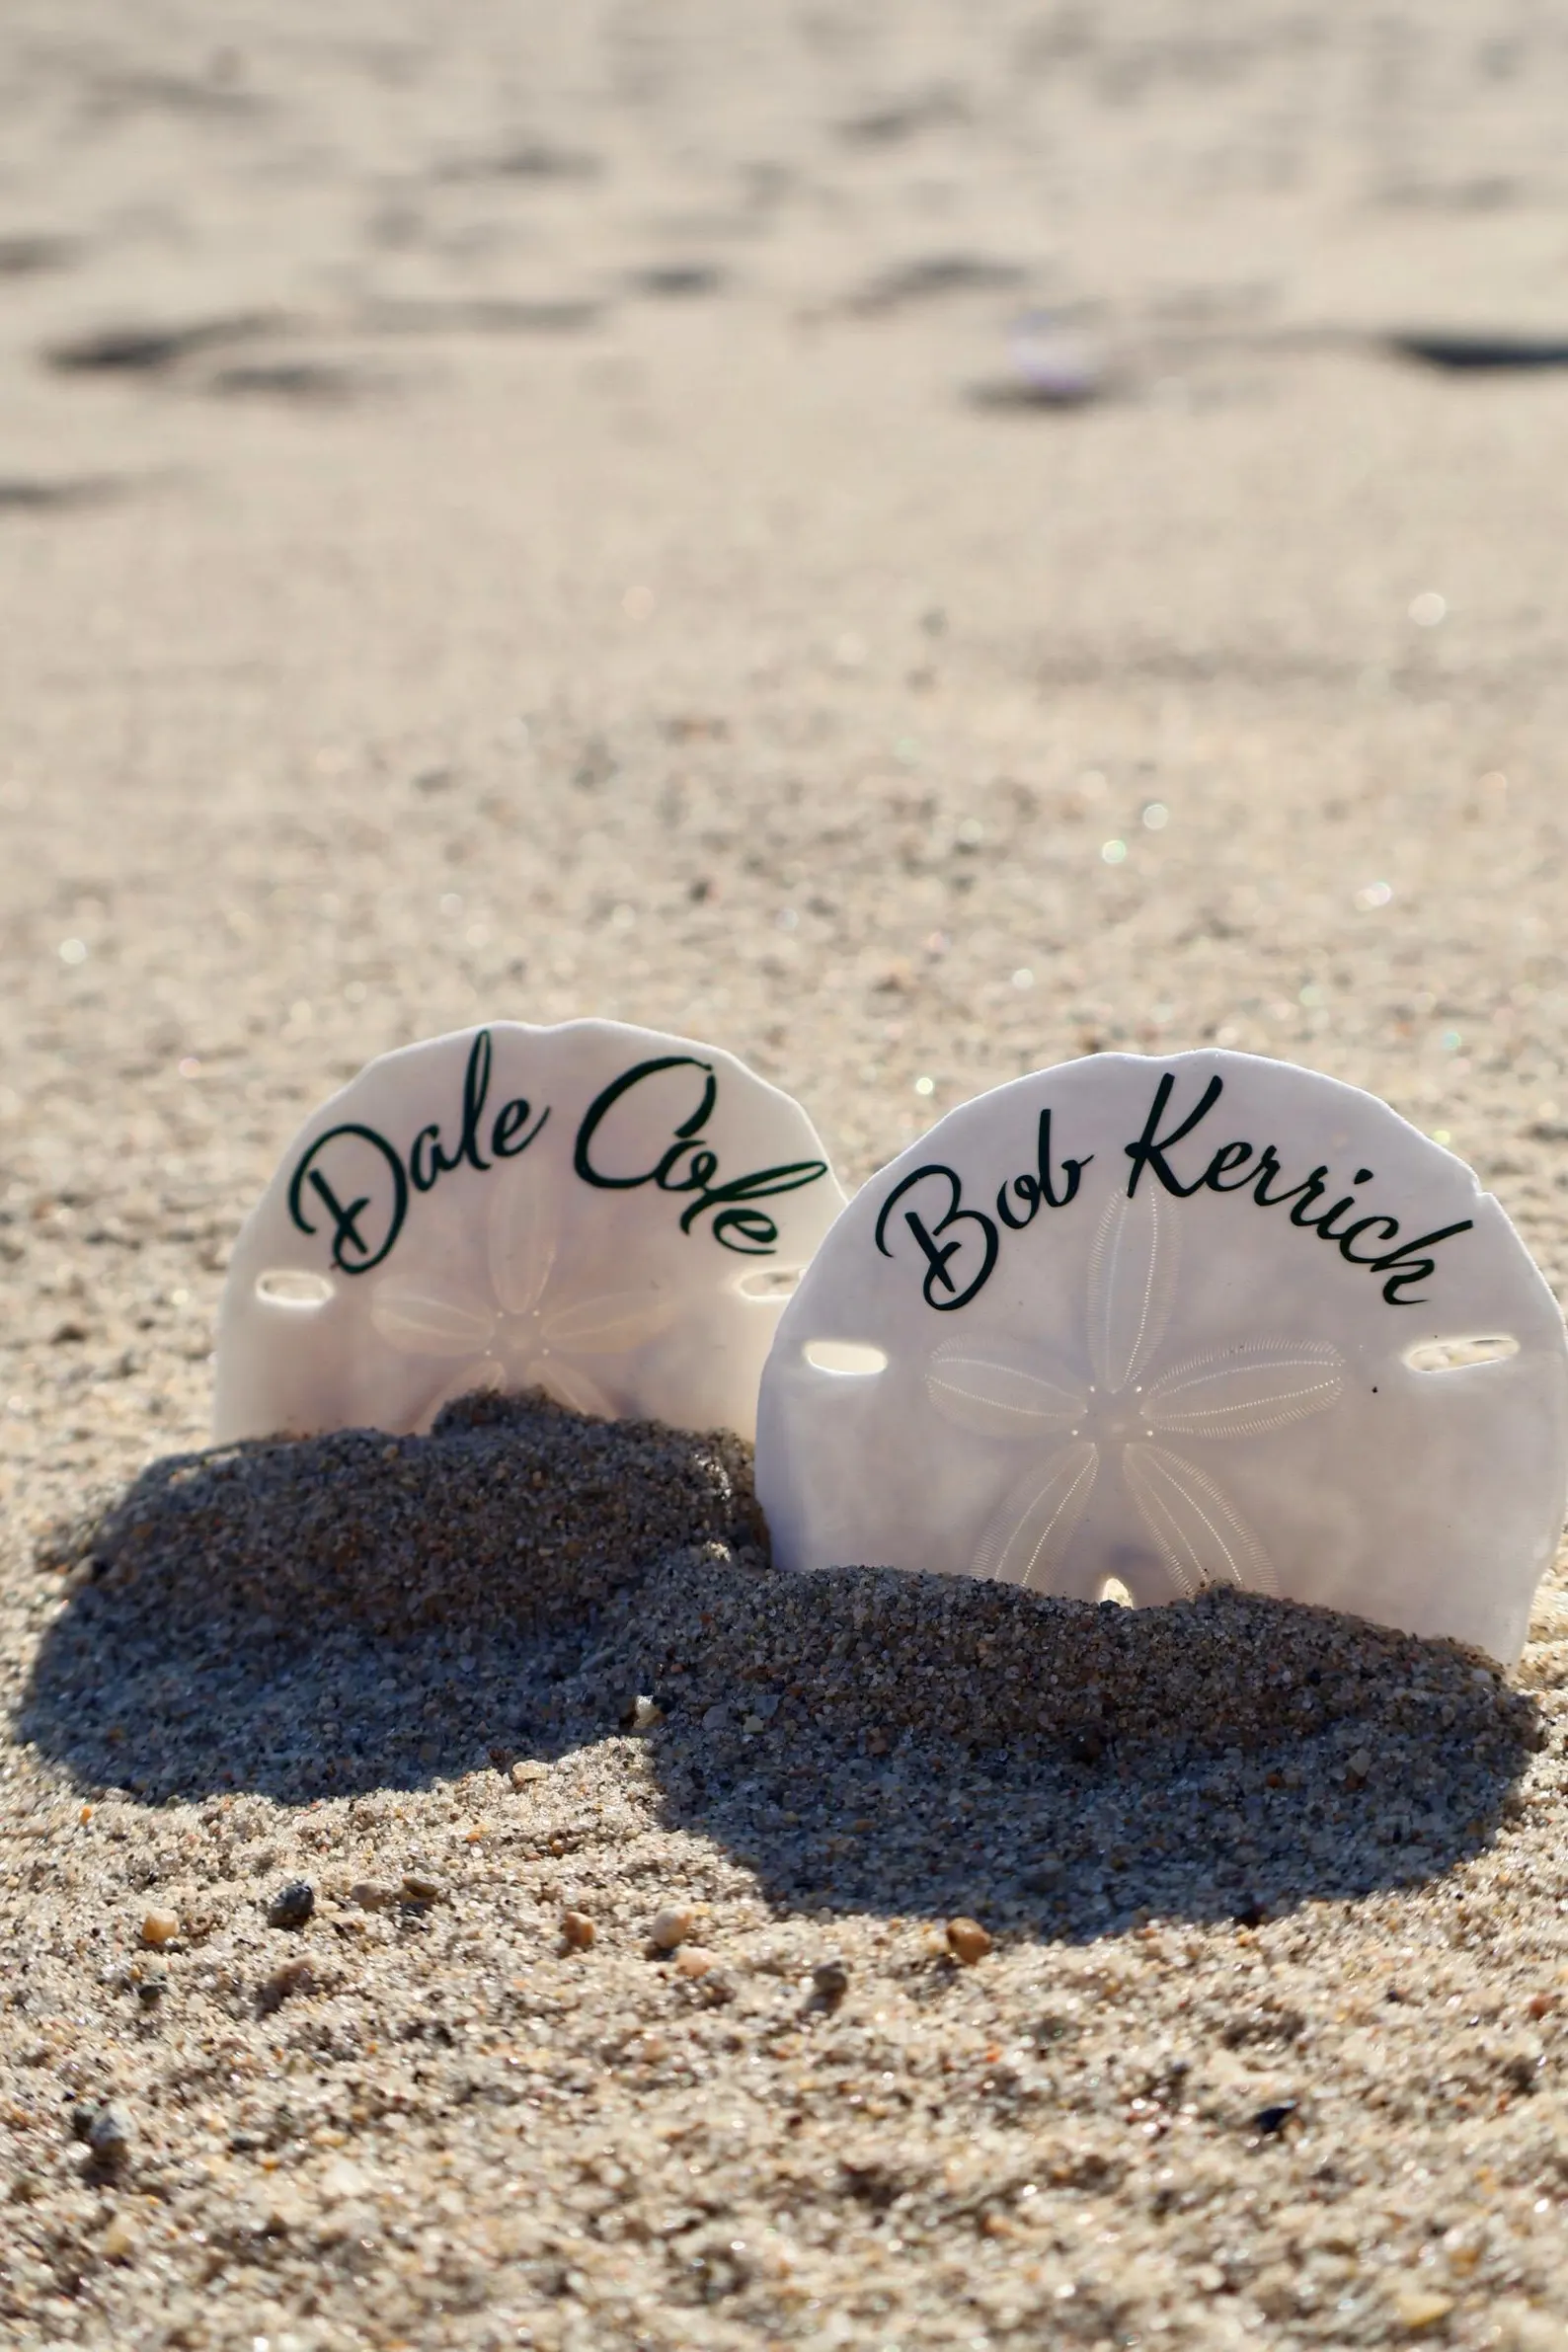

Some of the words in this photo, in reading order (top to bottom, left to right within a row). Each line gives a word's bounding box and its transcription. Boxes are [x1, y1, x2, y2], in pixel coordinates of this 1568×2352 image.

[287, 1029, 552, 1277] Dale
[572, 1056, 829, 1256] Cole
[874, 1108, 1095, 1312] Bob
[1123, 1072, 1474, 1306] Kerrich
